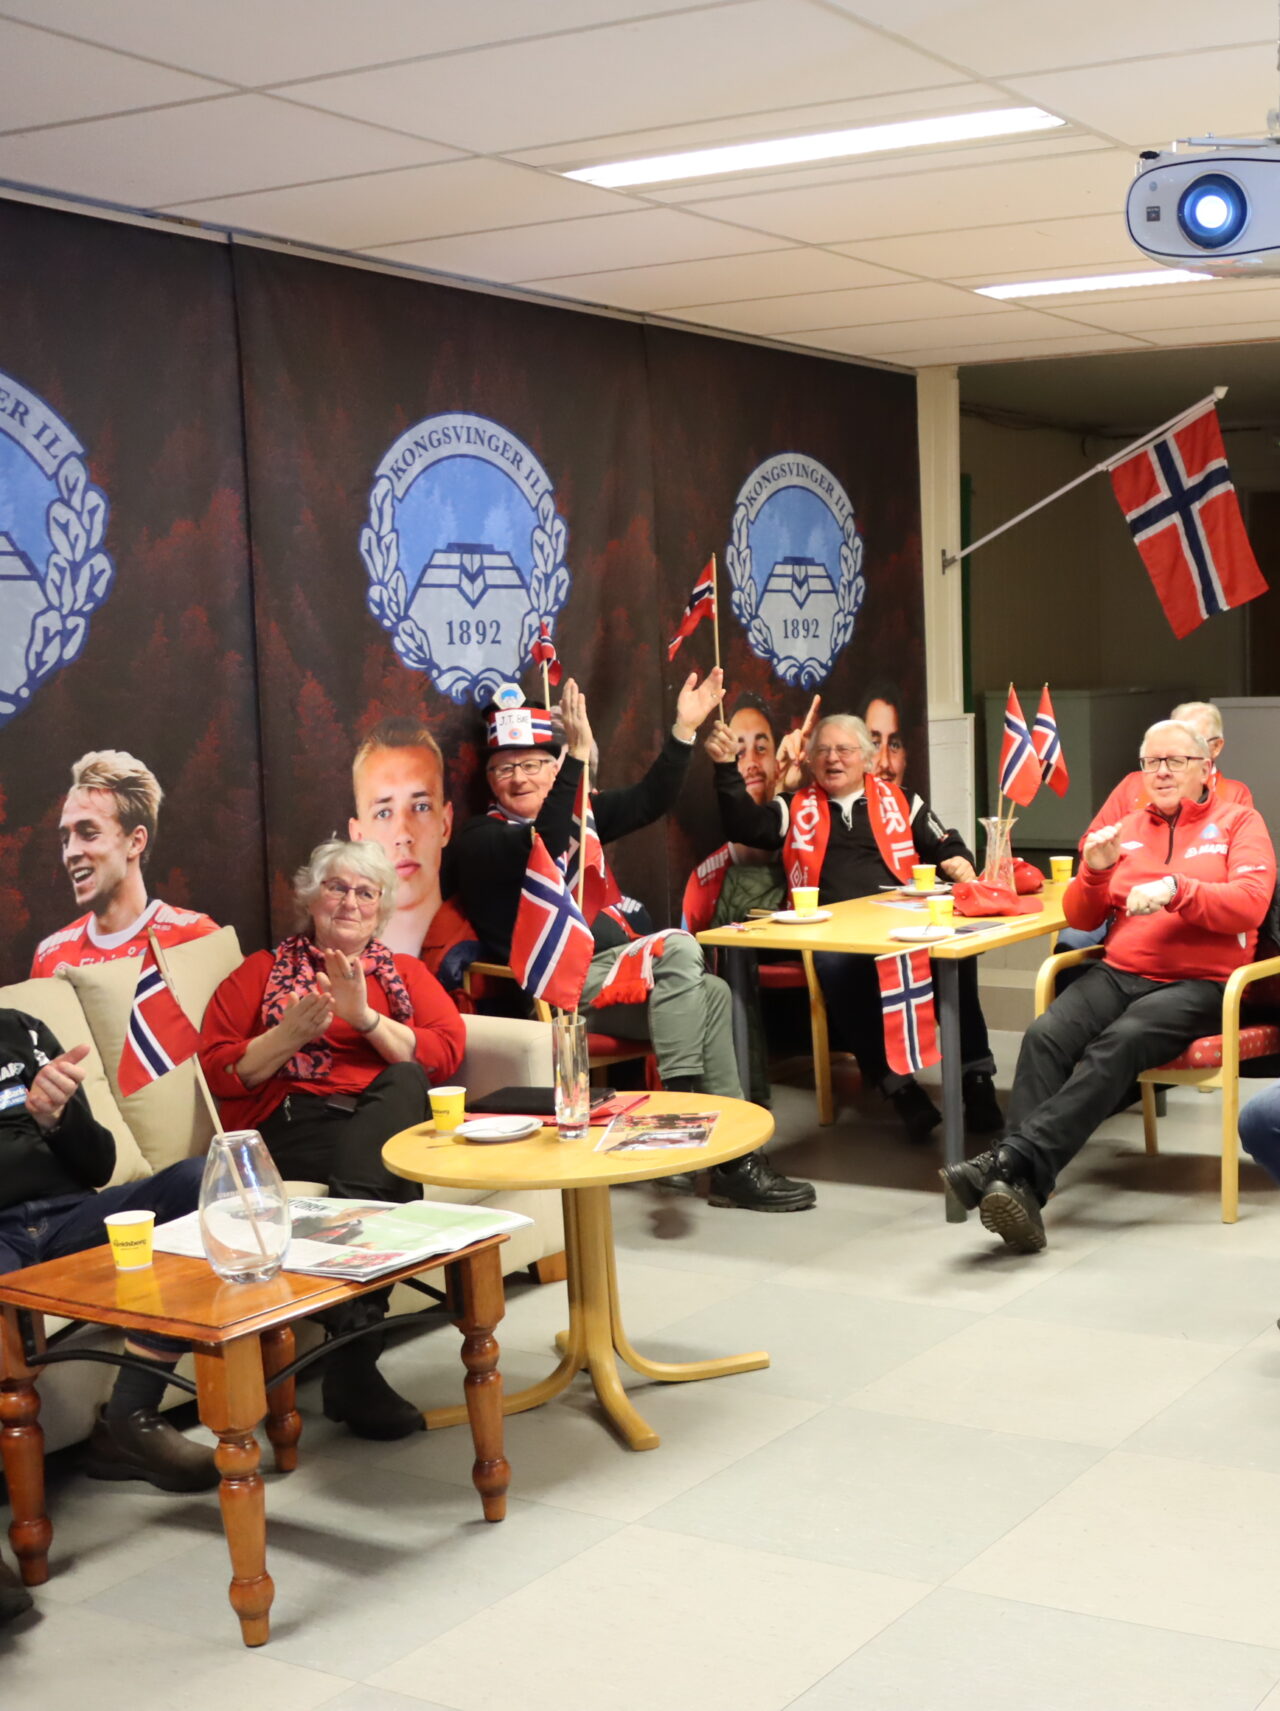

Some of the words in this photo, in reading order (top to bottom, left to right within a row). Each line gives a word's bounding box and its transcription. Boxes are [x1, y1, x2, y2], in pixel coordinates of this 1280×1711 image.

[32, 421, 62, 459] IL
[390, 426, 523, 480] KONGSVINGER
[524, 469, 543, 496] IL
[747, 462, 835, 508] KONGSVINGER
[834, 499, 847, 518] IL
[446, 620, 502, 645] 1892
[782, 618, 821, 640] 1892
[890, 839, 916, 872] IL
